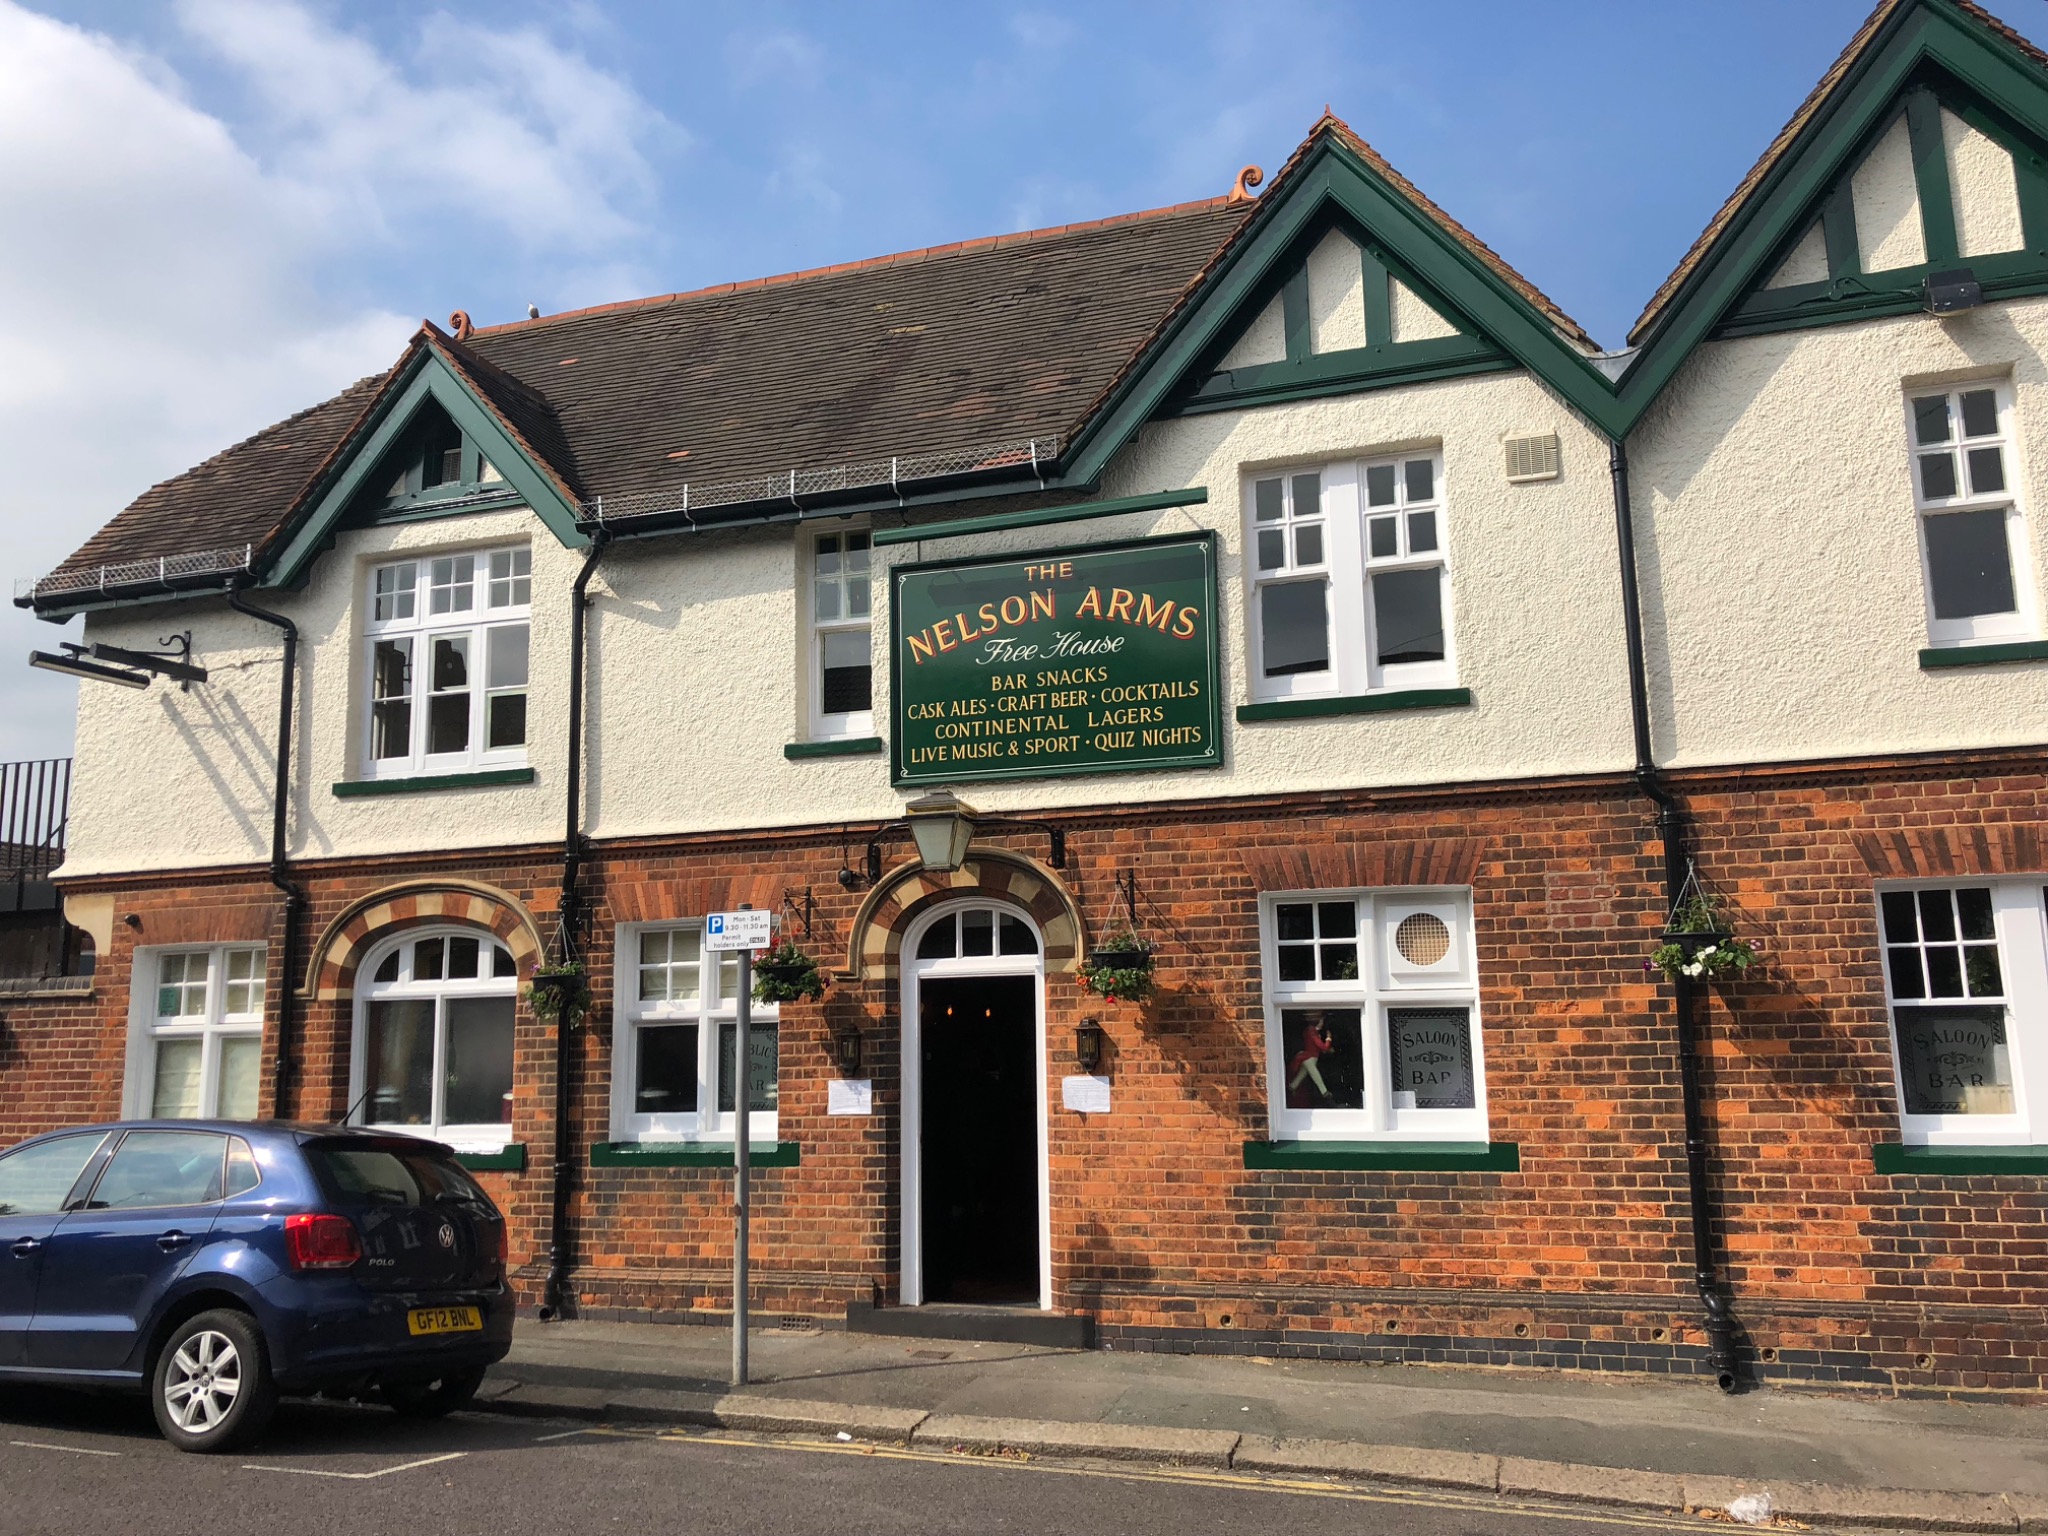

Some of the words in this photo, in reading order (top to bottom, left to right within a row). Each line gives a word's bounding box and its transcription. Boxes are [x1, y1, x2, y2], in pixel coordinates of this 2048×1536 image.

[1024, 562, 1074, 582] THE
[906, 588, 1056, 665] NELSON
[1076, 586, 1200, 641] ARMS
[976, 637, 1038, 665] Free
[1040, 631, 1125, 659] House
[991, 675, 1027, 692] BAR
[1036, 666, 1108, 687] SNACKS
[908, 702, 946, 720] CASK
[950, 699, 987, 717] ALES
[997, 693, 1047, 712] CRAFT
[1051, 689, 1087, 708] BEER
[1101, 680, 1199, 703] COCKTAILS
[935, 714, 1069, 740] CONTINENTAL
[1087, 706, 1164, 728] LAGERS
[911, 746, 948, 764] LIVE
[951, 741, 1004, 760] MUSIC
[1007, 742, 1019, 756] &
[1024, 736, 1081, 755] SPORT
[1094, 729, 1136, 752] QUIZ
[1142, 726, 1201, 746] NIGHTS
[1402, 1031, 1459, 1049] SALOON
[1914, 1029, 1991, 1050] SALOON
[1929, 1073, 1983, 1088] BAR
[369, 1258, 395, 1266] POLO
[417, 1310, 449, 1330] GF12
[452, 1308, 474, 1327] BNL
